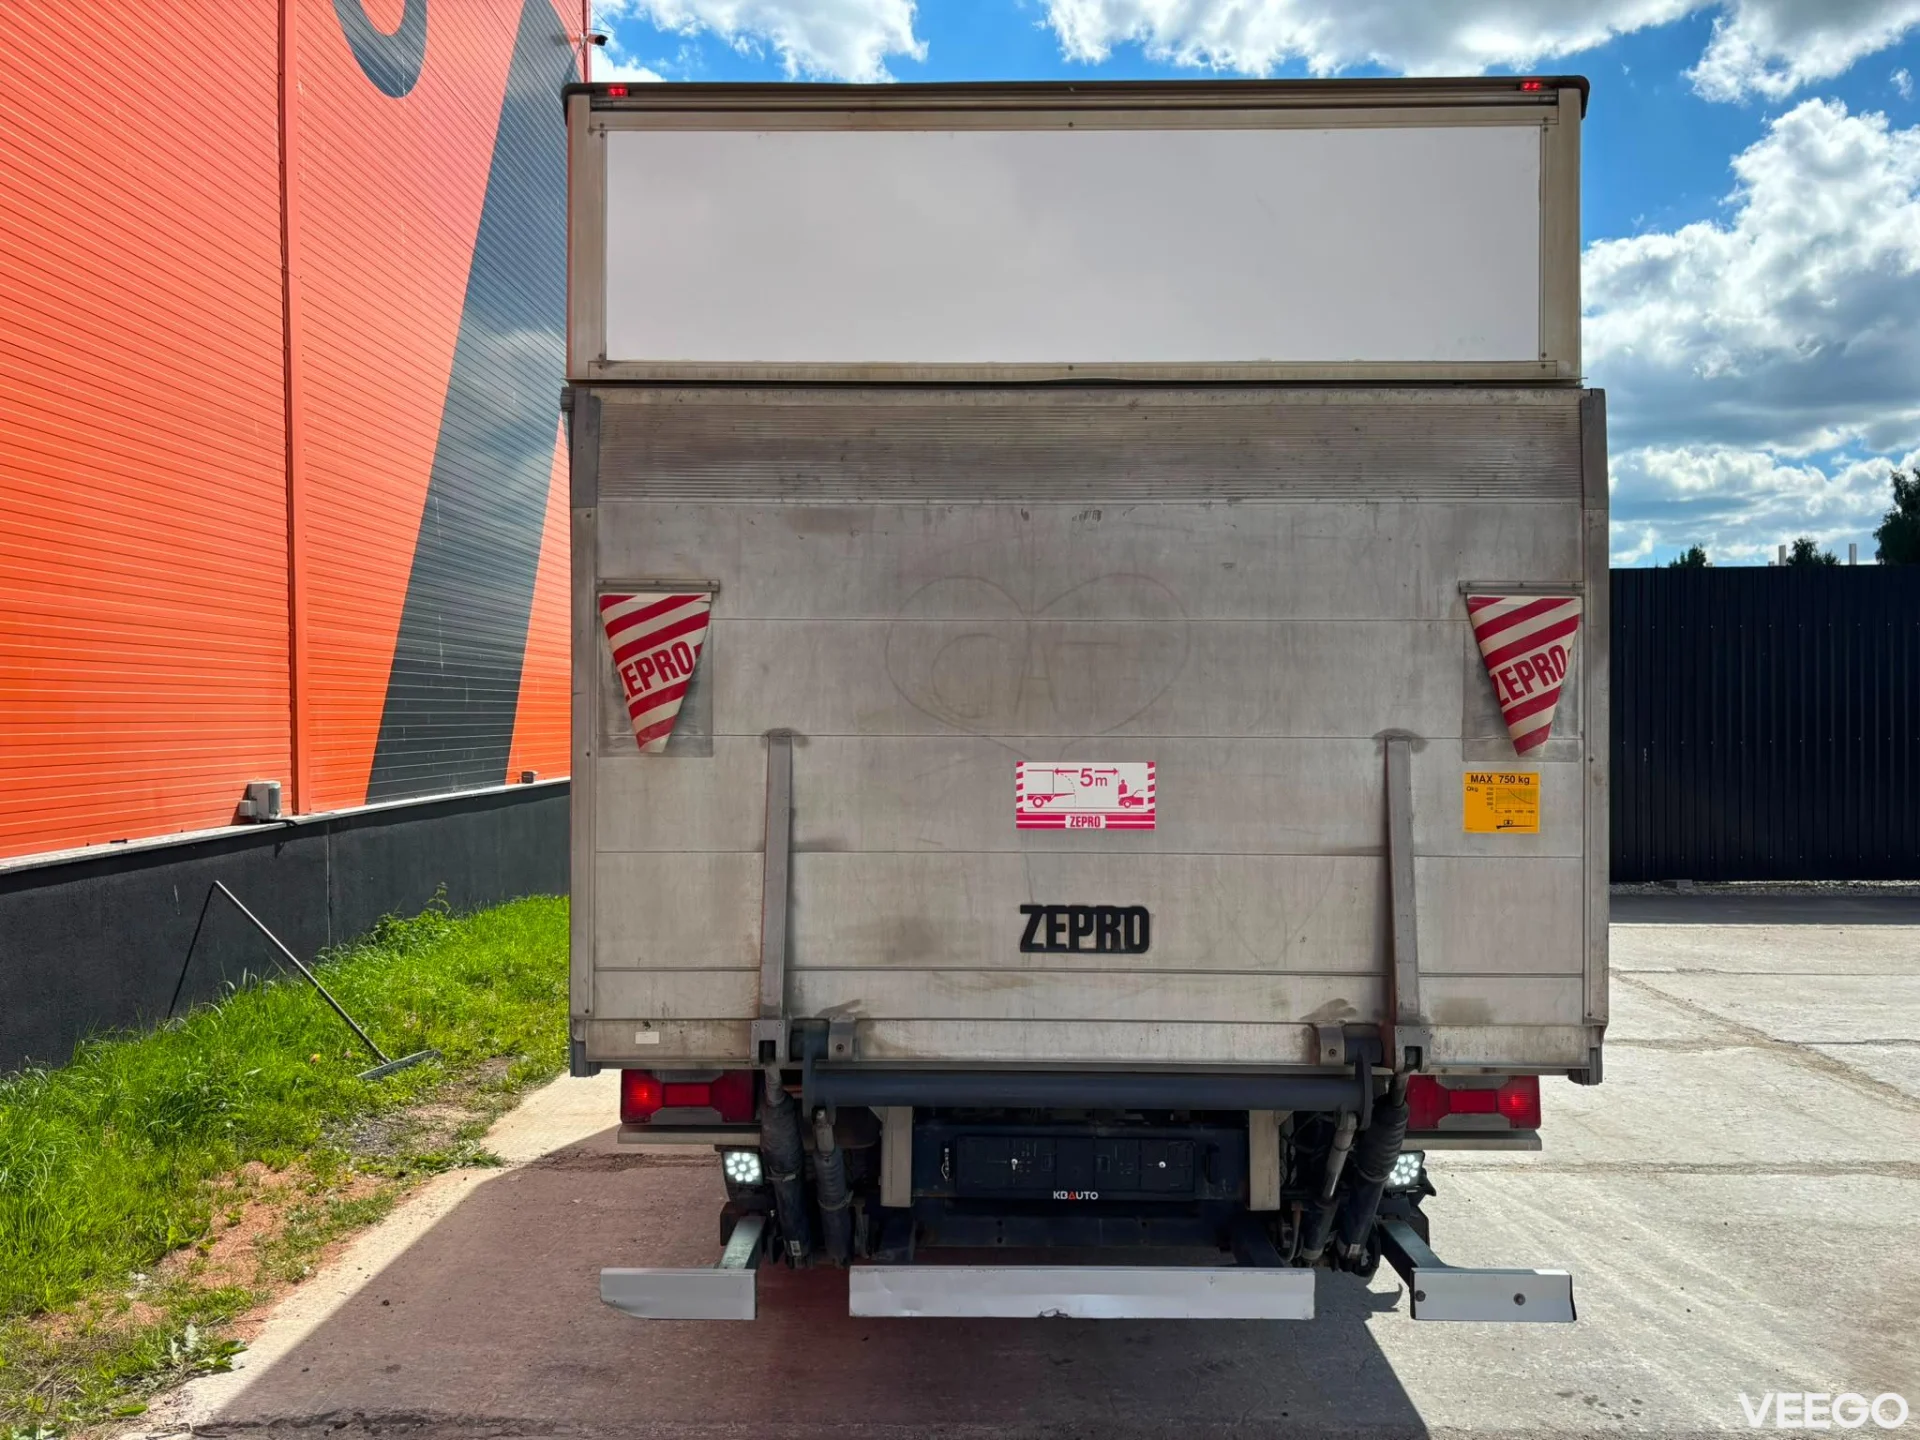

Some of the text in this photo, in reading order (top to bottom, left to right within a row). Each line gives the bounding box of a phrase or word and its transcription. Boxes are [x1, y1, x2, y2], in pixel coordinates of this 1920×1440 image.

[1470, 774, 1530, 786] MAX 750 kg
[1070, 815, 1101, 828] ZEPRO
[1019, 904, 1150, 954] ZEPRO
